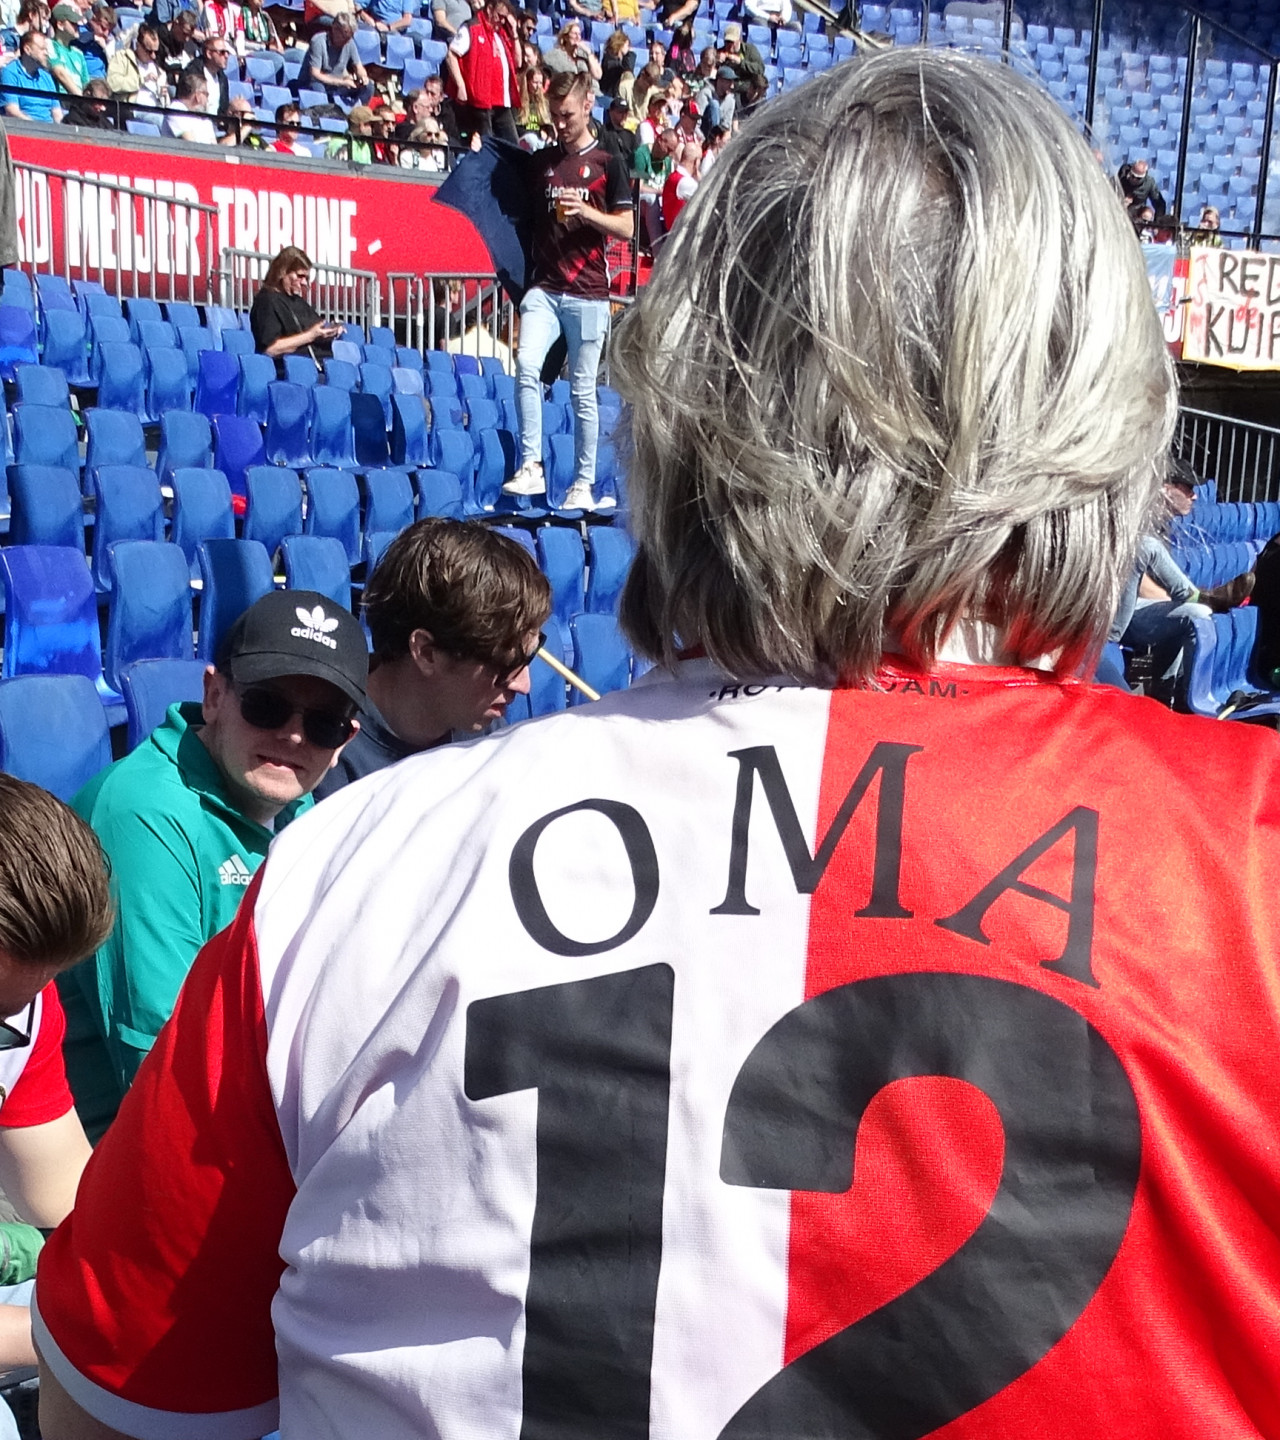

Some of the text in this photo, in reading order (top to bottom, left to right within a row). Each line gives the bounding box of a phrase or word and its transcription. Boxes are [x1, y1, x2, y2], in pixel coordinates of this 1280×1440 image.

[65, 170, 201, 277] MEIJER
[212, 187, 357, 288] TRIBUNE
[290, 626, 337, 650] adidas
[509, 741, 1102, 990] OMA
